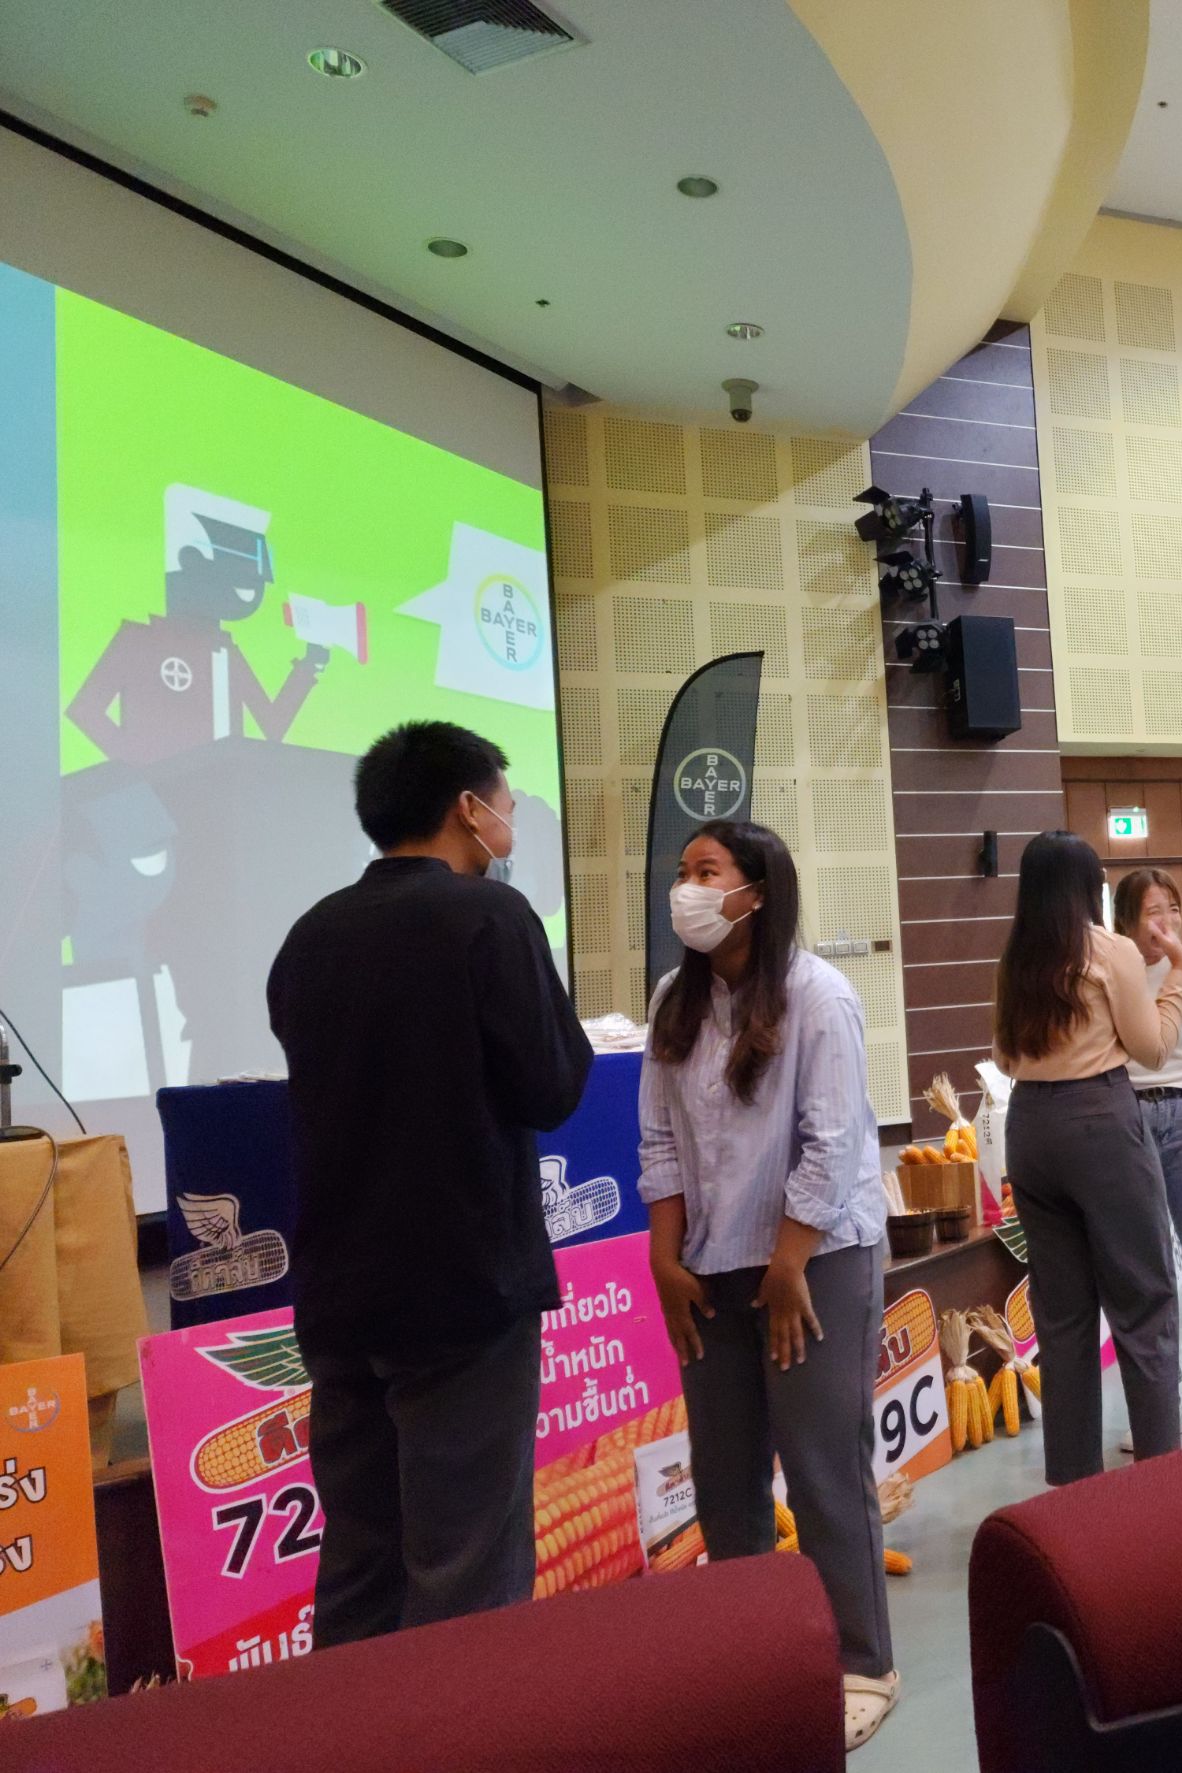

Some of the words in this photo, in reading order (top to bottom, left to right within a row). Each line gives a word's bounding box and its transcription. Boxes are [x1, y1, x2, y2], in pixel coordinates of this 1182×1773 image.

[480, 606, 537, 637] BAYER
[502, 583, 517, 662] BAYER
[680, 777, 741, 792] BAYER
[703, 754, 719, 816] BAYER
[536, 1365, 649, 1438] วามชื้นต่ำ
[872, 1374, 938, 1463] 9C
[664, 1486, 694, 1508] 7212C
